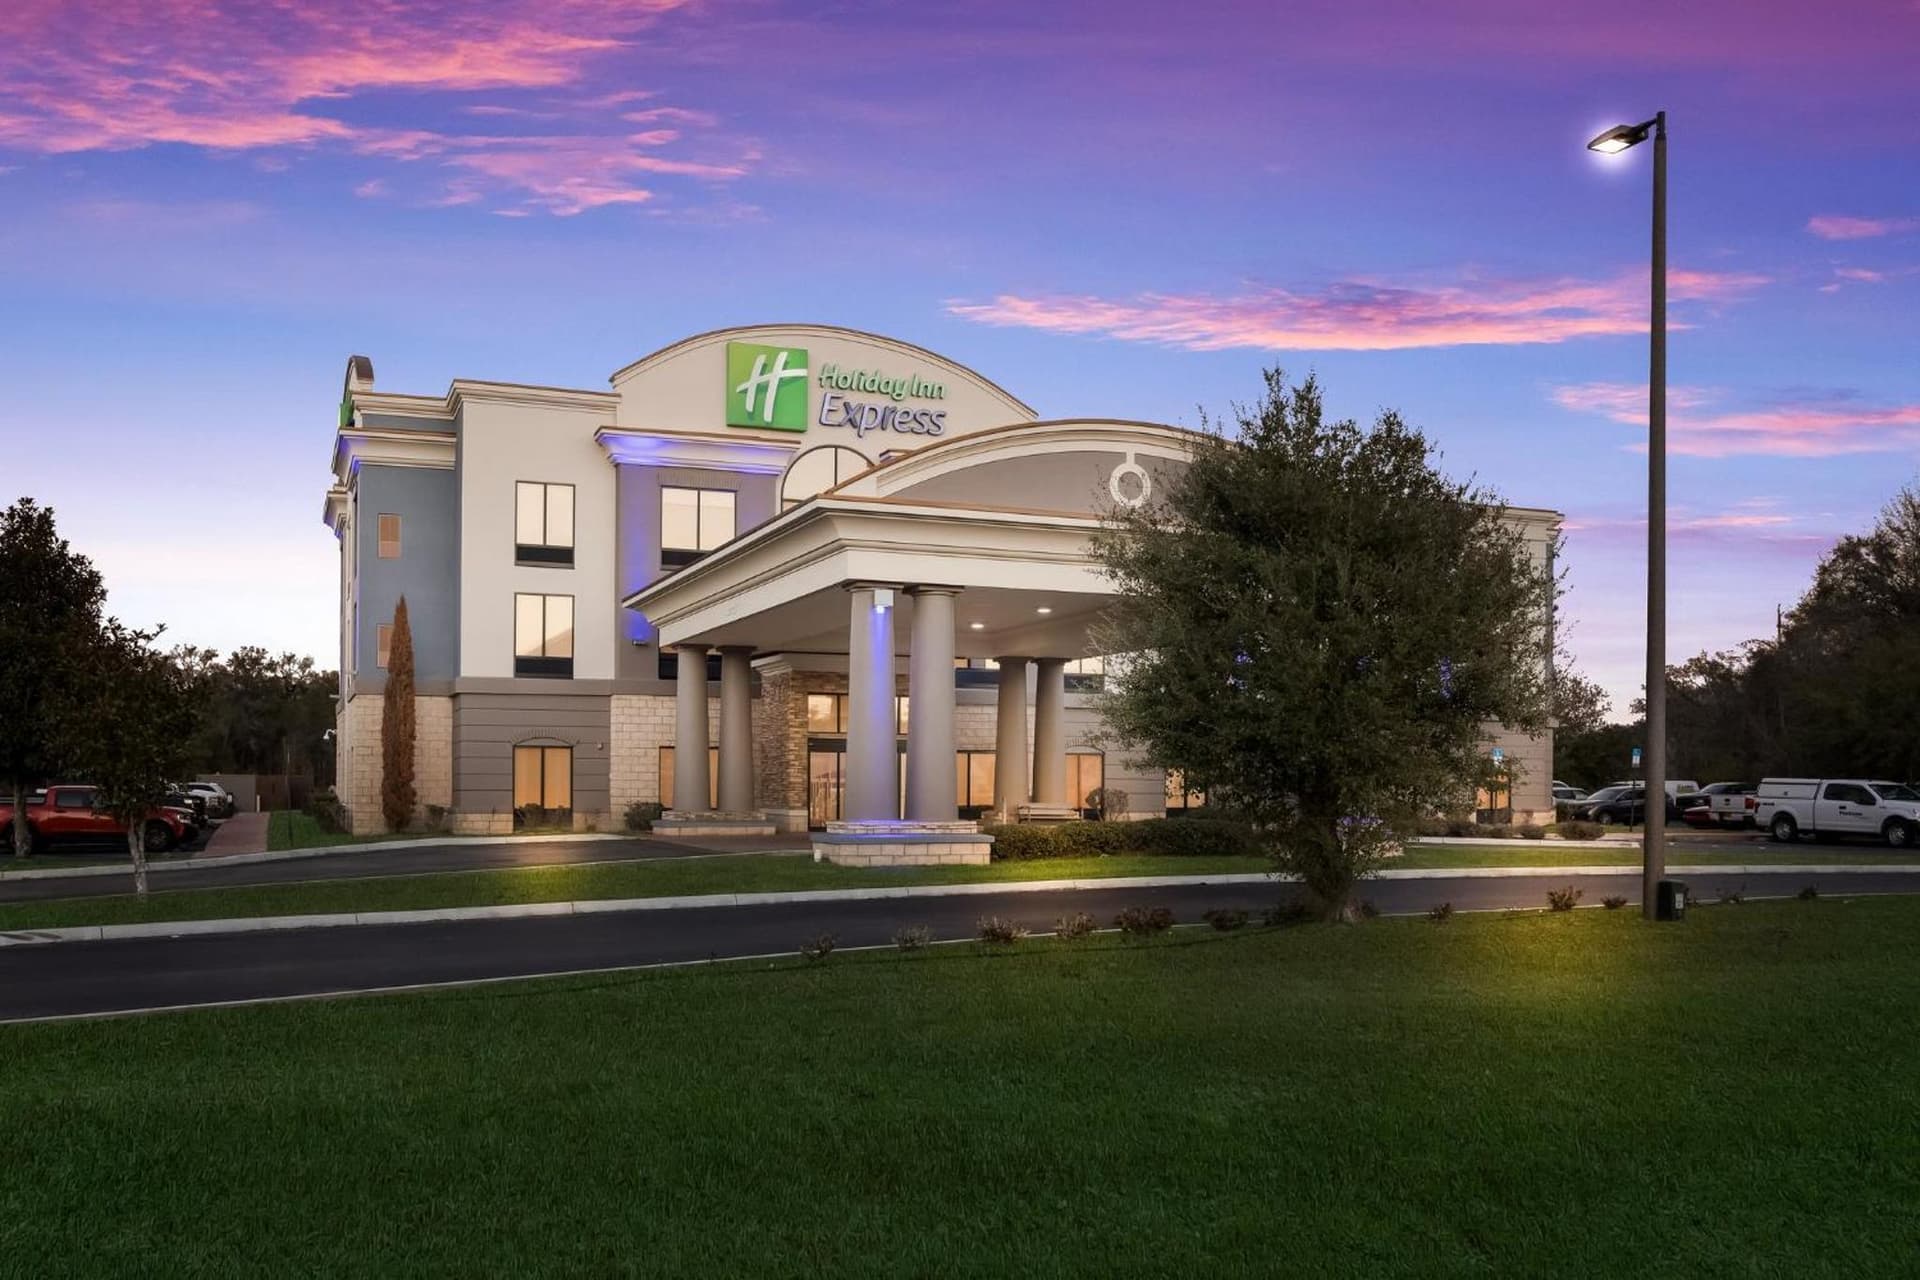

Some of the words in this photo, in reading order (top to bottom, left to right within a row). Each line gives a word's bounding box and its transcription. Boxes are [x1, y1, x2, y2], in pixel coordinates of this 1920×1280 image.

[736, 351, 808, 423] H
[818, 363, 908, 401] Holiday
[911, 374, 945, 399] Inn
[819, 391, 946, 437] Express
